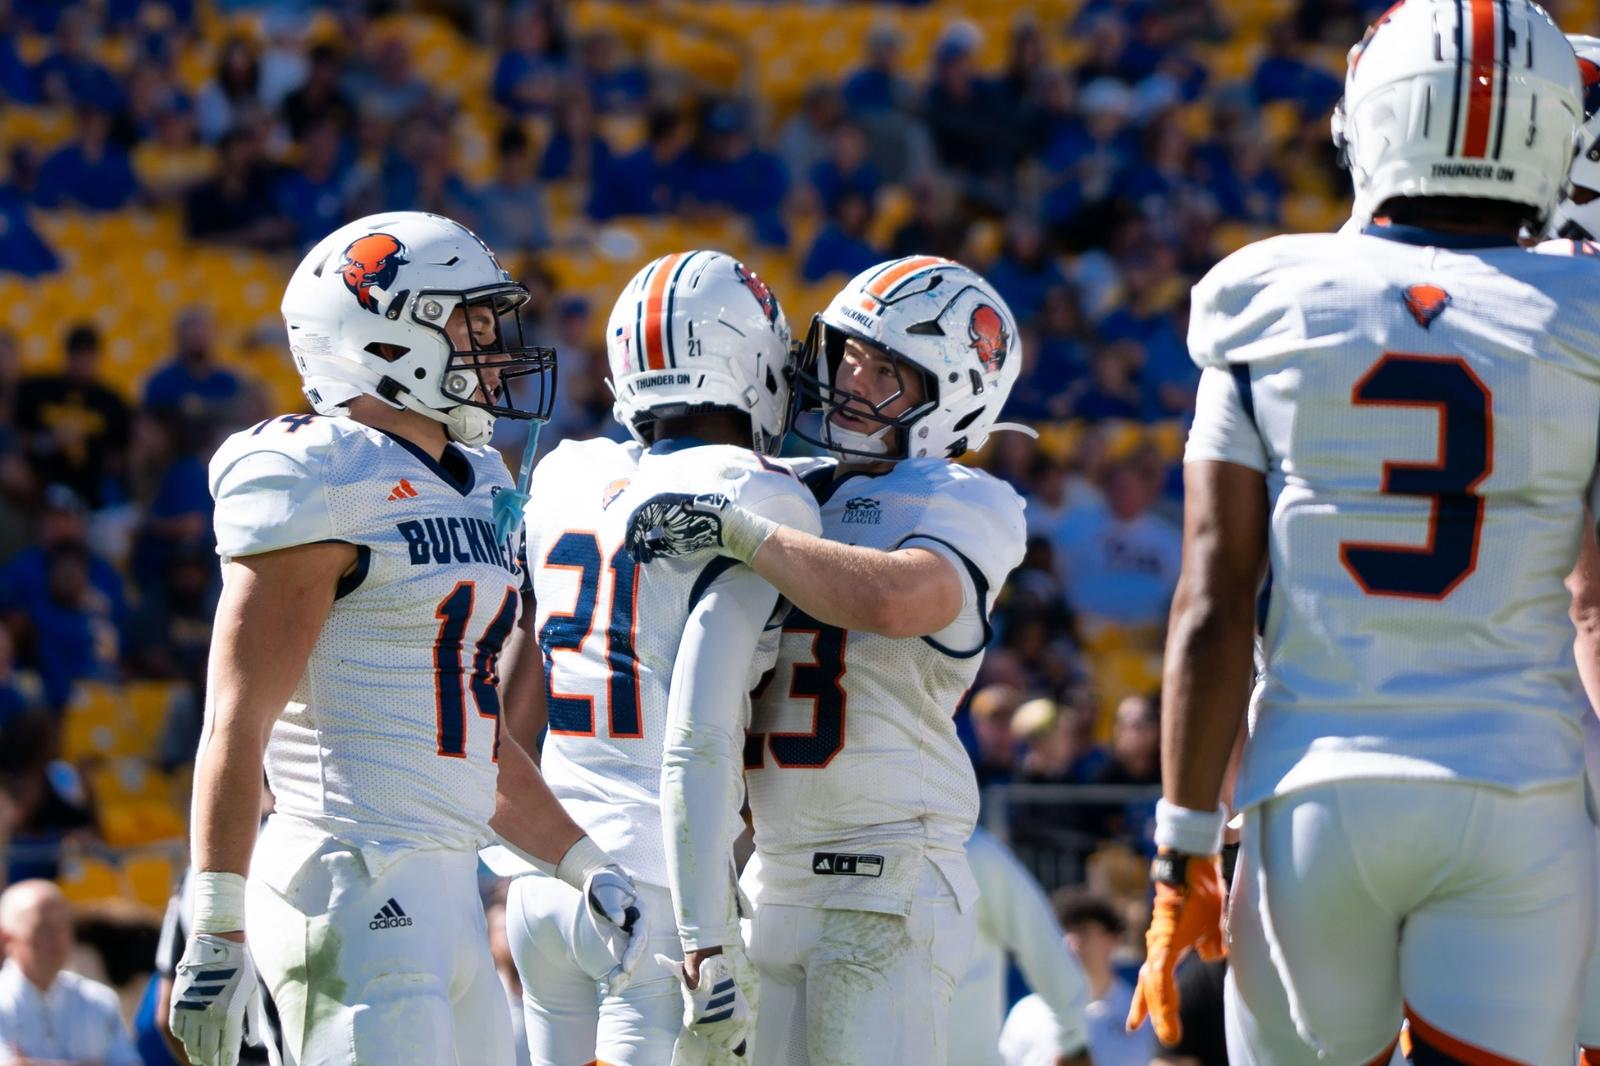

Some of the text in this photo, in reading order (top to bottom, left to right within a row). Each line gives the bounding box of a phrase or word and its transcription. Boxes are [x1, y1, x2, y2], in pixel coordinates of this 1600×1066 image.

[1431, 163, 1515, 182] THUNDER ON
[840, 305, 874, 329] BUCKNELL
[687, 339, 702, 357] 21
[635, 374, 690, 390] THUNDER ON
[1338, 351, 1494, 604] 3
[841, 515, 880, 525] LEAGUE
[845, 509, 883, 518] PATRIOT
[538, 528, 644, 738] 21
[433, 580, 518, 763] 14
[743, 606, 849, 769] 3
[369, 916, 413, 931] adidas
